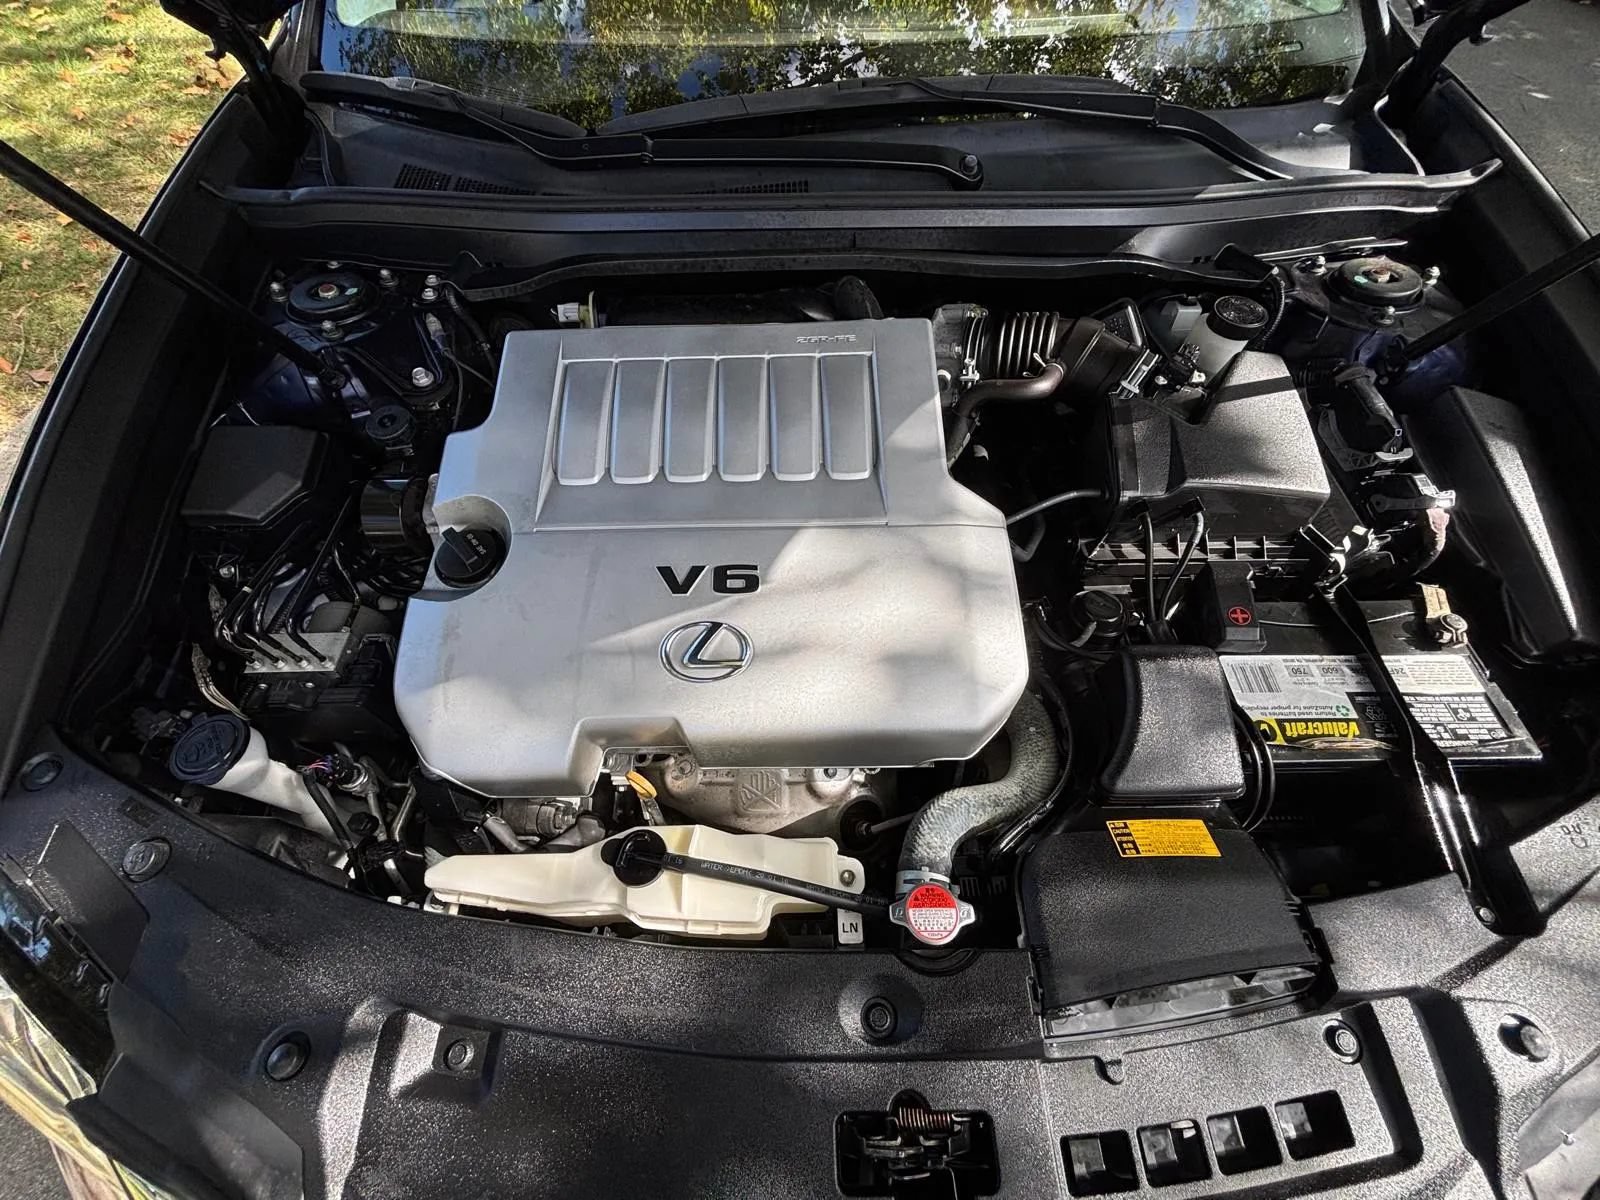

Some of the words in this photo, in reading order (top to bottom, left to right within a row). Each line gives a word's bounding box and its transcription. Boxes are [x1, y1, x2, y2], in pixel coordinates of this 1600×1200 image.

[796, 334, 857, 344] 2GR-FE
[656, 564, 760, 595] V6
[1291, 667, 1307, 675] 750
[1284, 721, 1360, 741] Valucraft
[842, 922, 859, 933] LN
